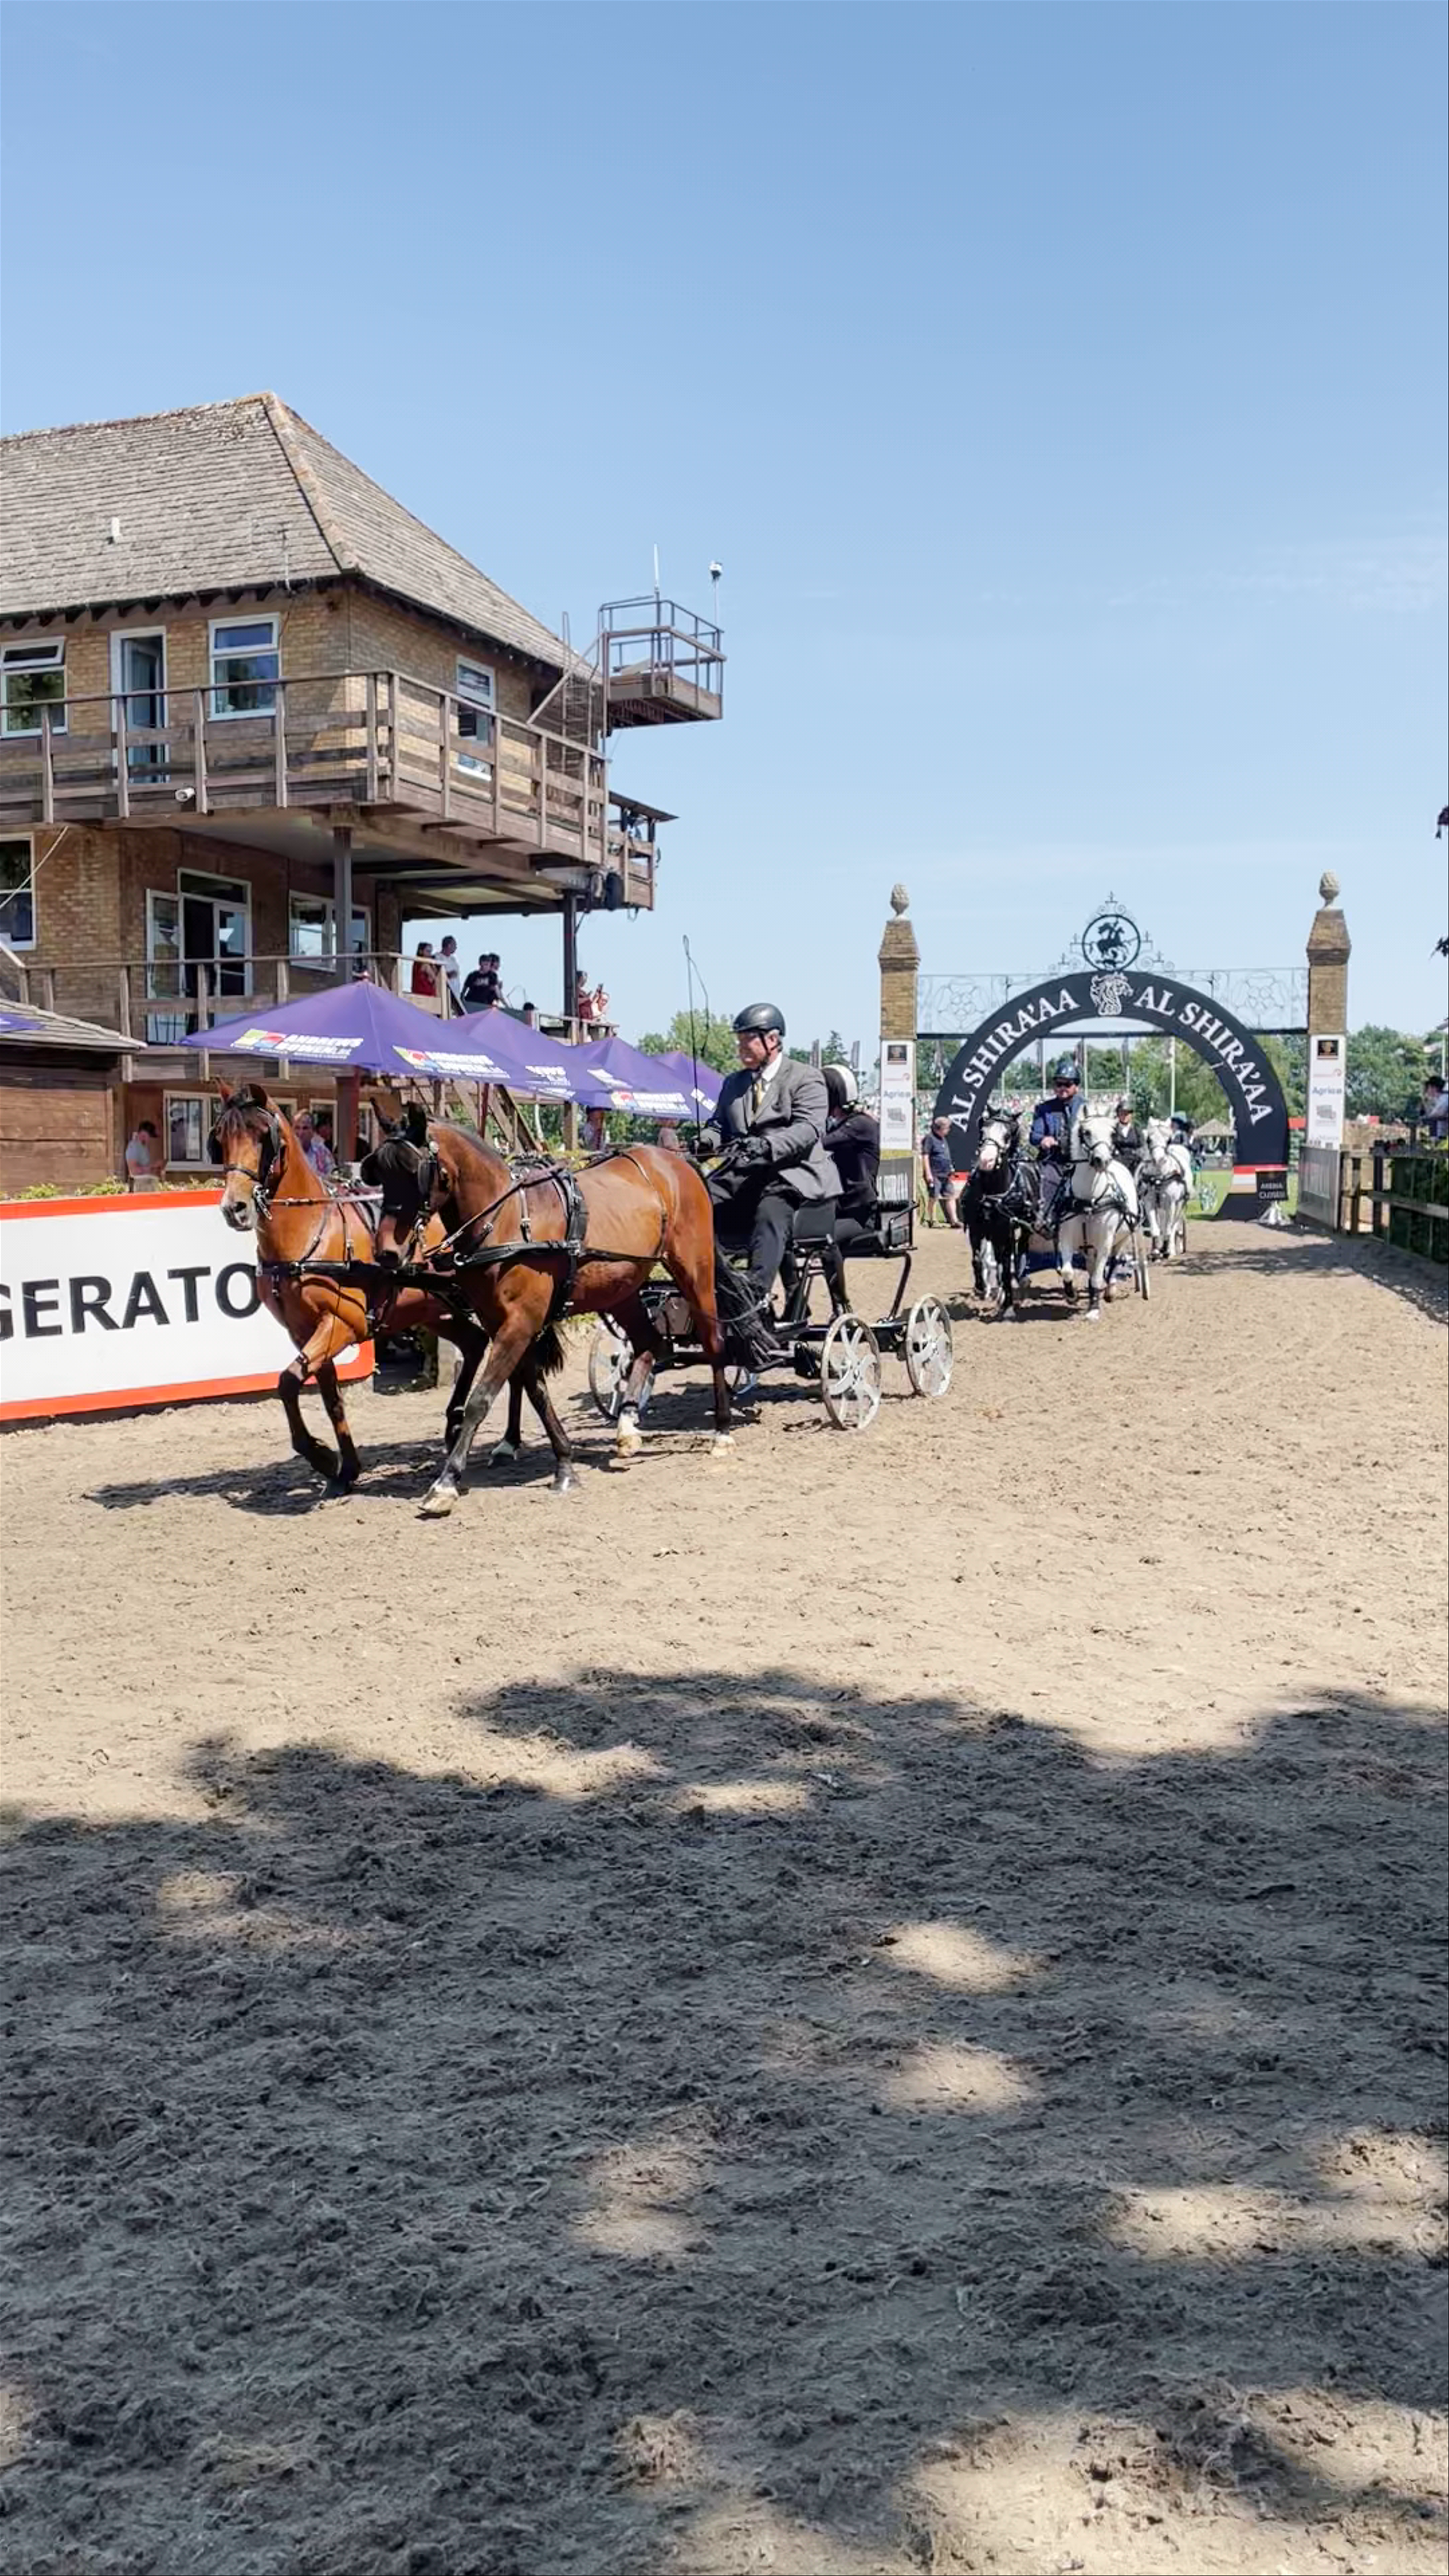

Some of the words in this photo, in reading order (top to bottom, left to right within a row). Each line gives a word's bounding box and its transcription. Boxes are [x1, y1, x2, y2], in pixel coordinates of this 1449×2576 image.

[948, 1093, 976, 1132] AL
[962, 989, 1080, 1089] SHIRA'AA
[1134, 986, 1175, 1016] AL
[1178, 1002, 1274, 1126] SHIRA'AA
[0, 1263, 261, 1341] ERATO
